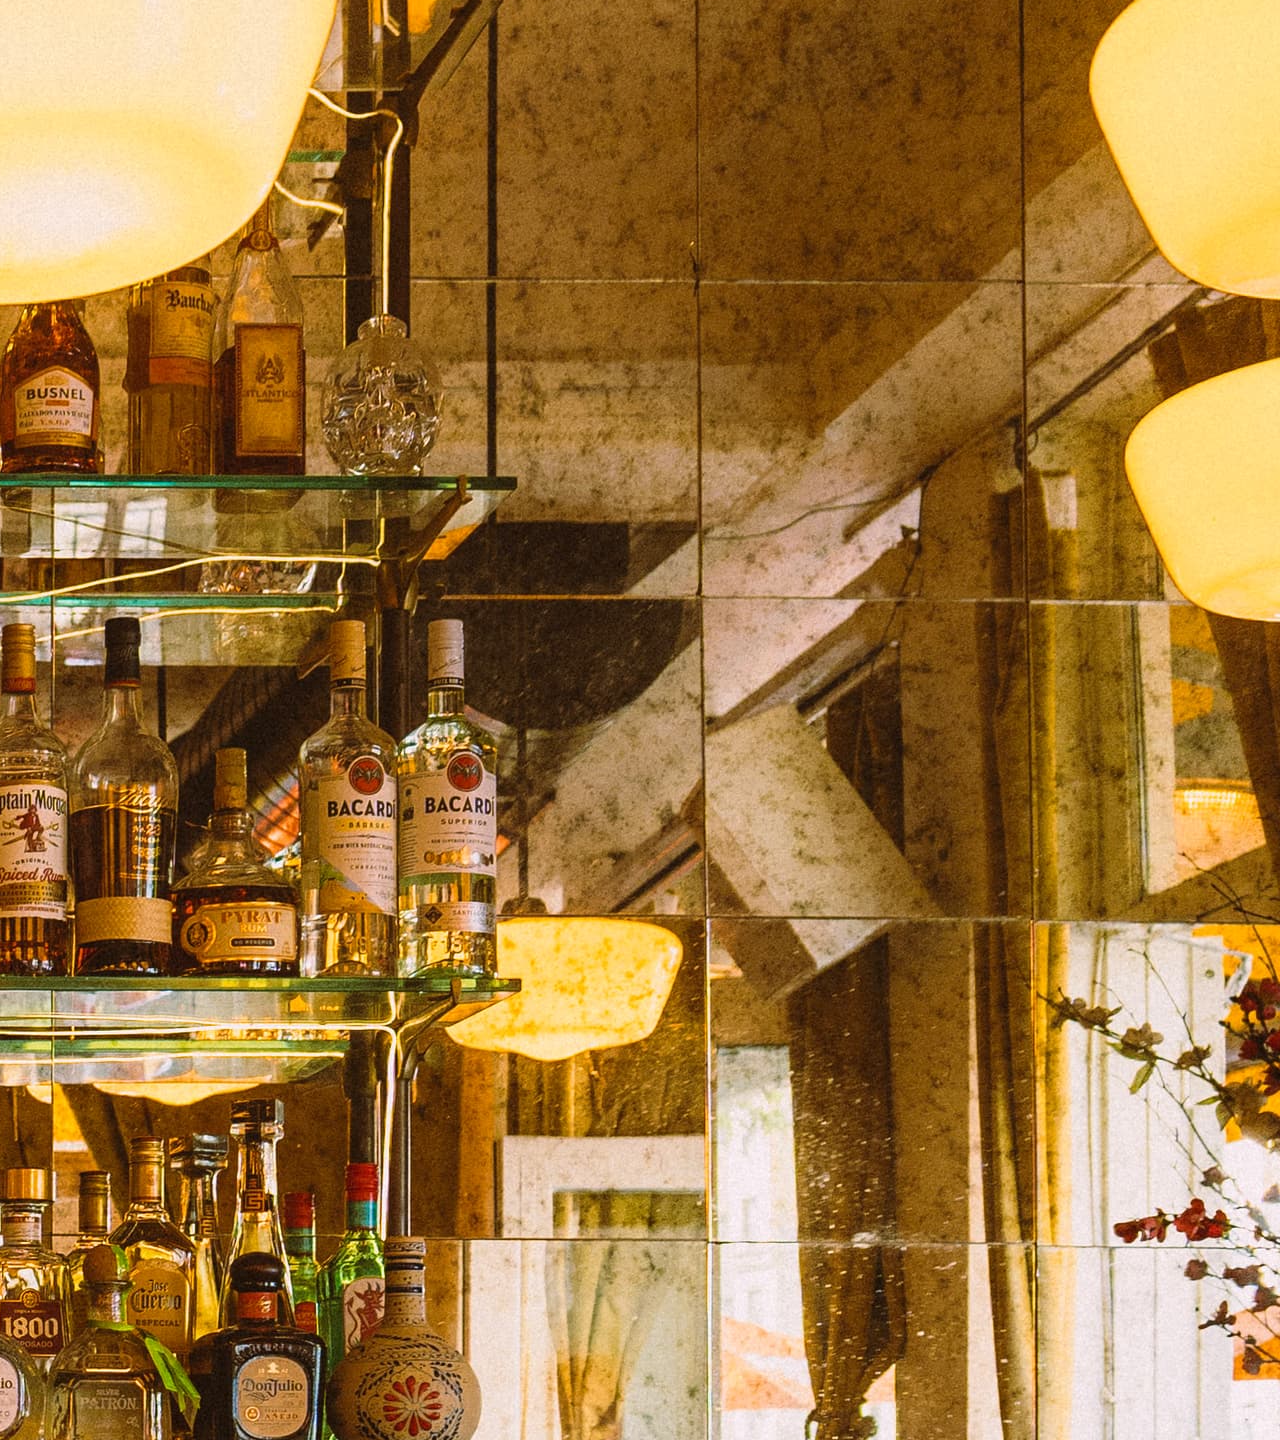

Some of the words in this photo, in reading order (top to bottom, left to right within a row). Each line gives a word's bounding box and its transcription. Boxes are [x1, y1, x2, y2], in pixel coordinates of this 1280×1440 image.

[26, 388, 86, 402] BUSNEL
[327, 799, 397, 820] BACARDÍ
[424, 796, 496, 817] BACARDÍ
[440, 818, 488, 827] SUPERIOR
[221, 911, 282, 925] PYRAT
[241, 924, 268, 933] RUM
[130, 1289, 182, 1313] Cuervo
[2, 1316, 60, 1339] 1800
[135, 1318, 181, 1327] ESPECIAL
[96, 1388, 120, 1396] SILVER
[269, 1378, 303, 1398] Julio
[80, 1393, 138, 1410] PATRÓN
[264, 1411, 299, 1420] AÑEJO
